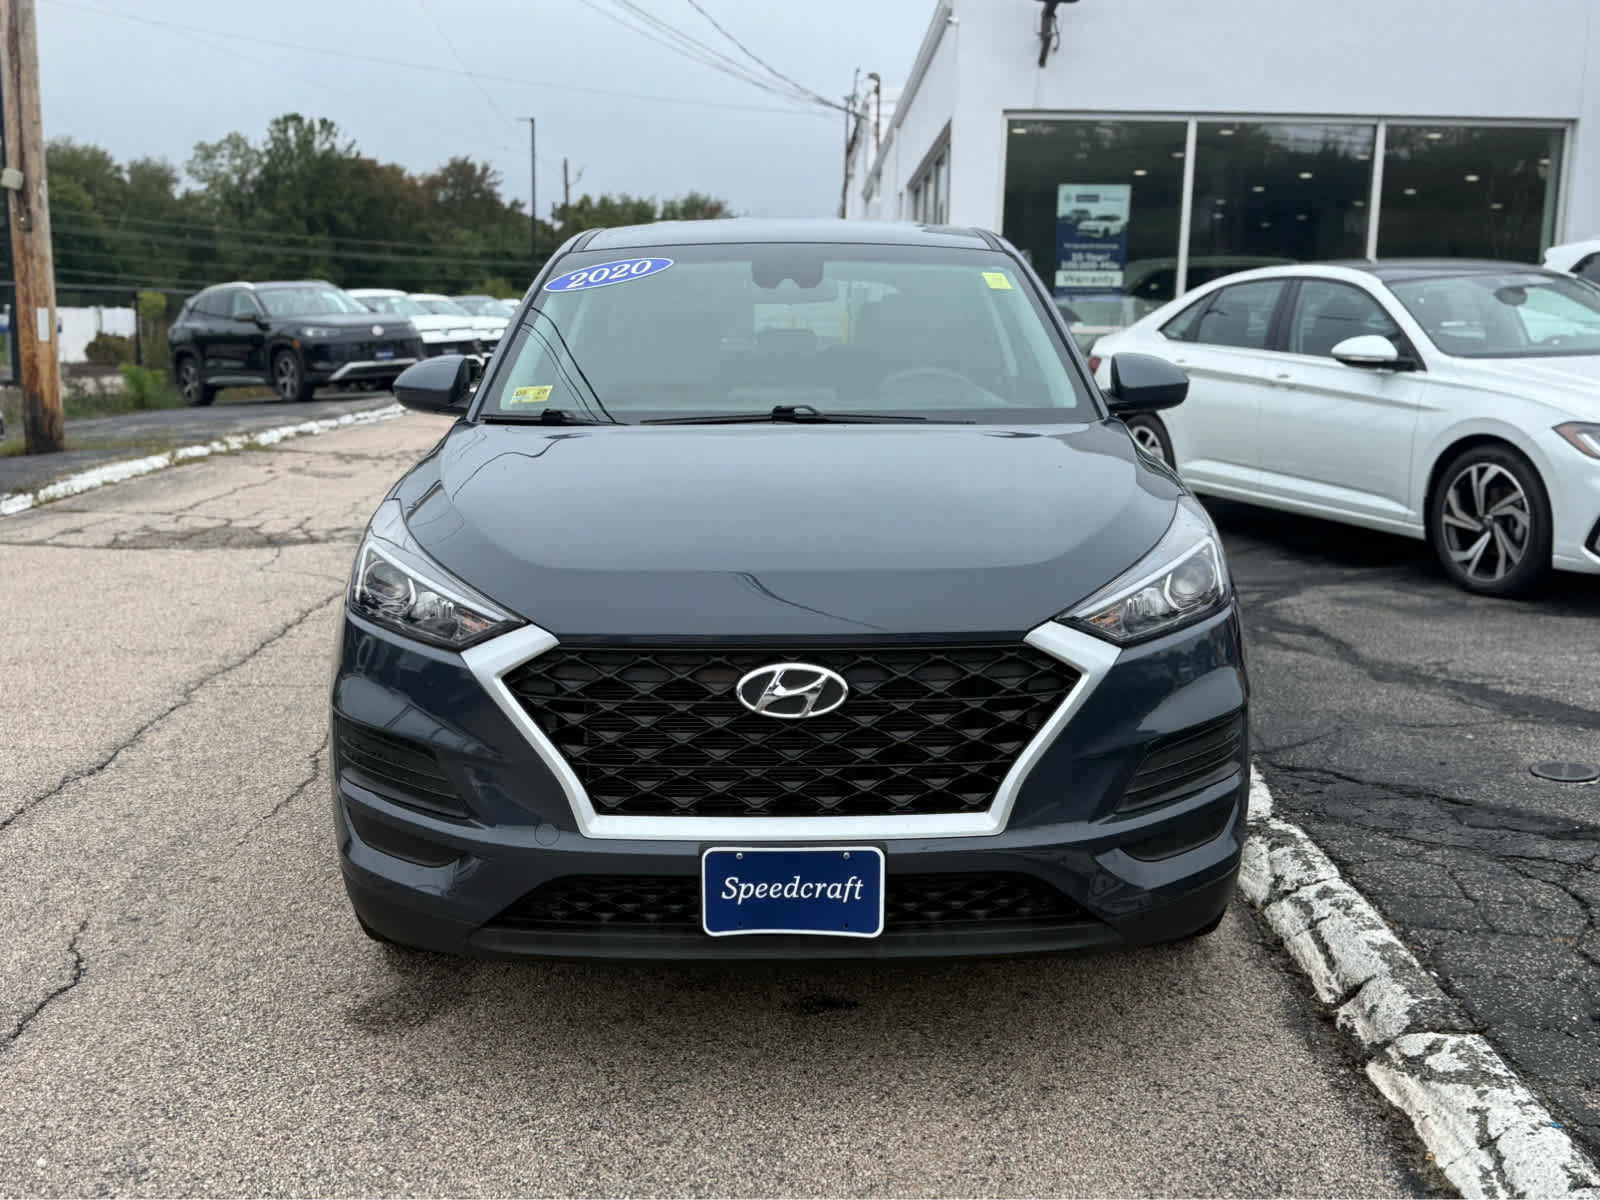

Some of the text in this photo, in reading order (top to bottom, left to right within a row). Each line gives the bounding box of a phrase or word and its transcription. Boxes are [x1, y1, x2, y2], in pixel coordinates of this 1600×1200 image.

[565, 260, 652, 290] 2020
[1063, 273, 1115, 285] Warranty
[721, 875, 864, 905] Speedcraft
